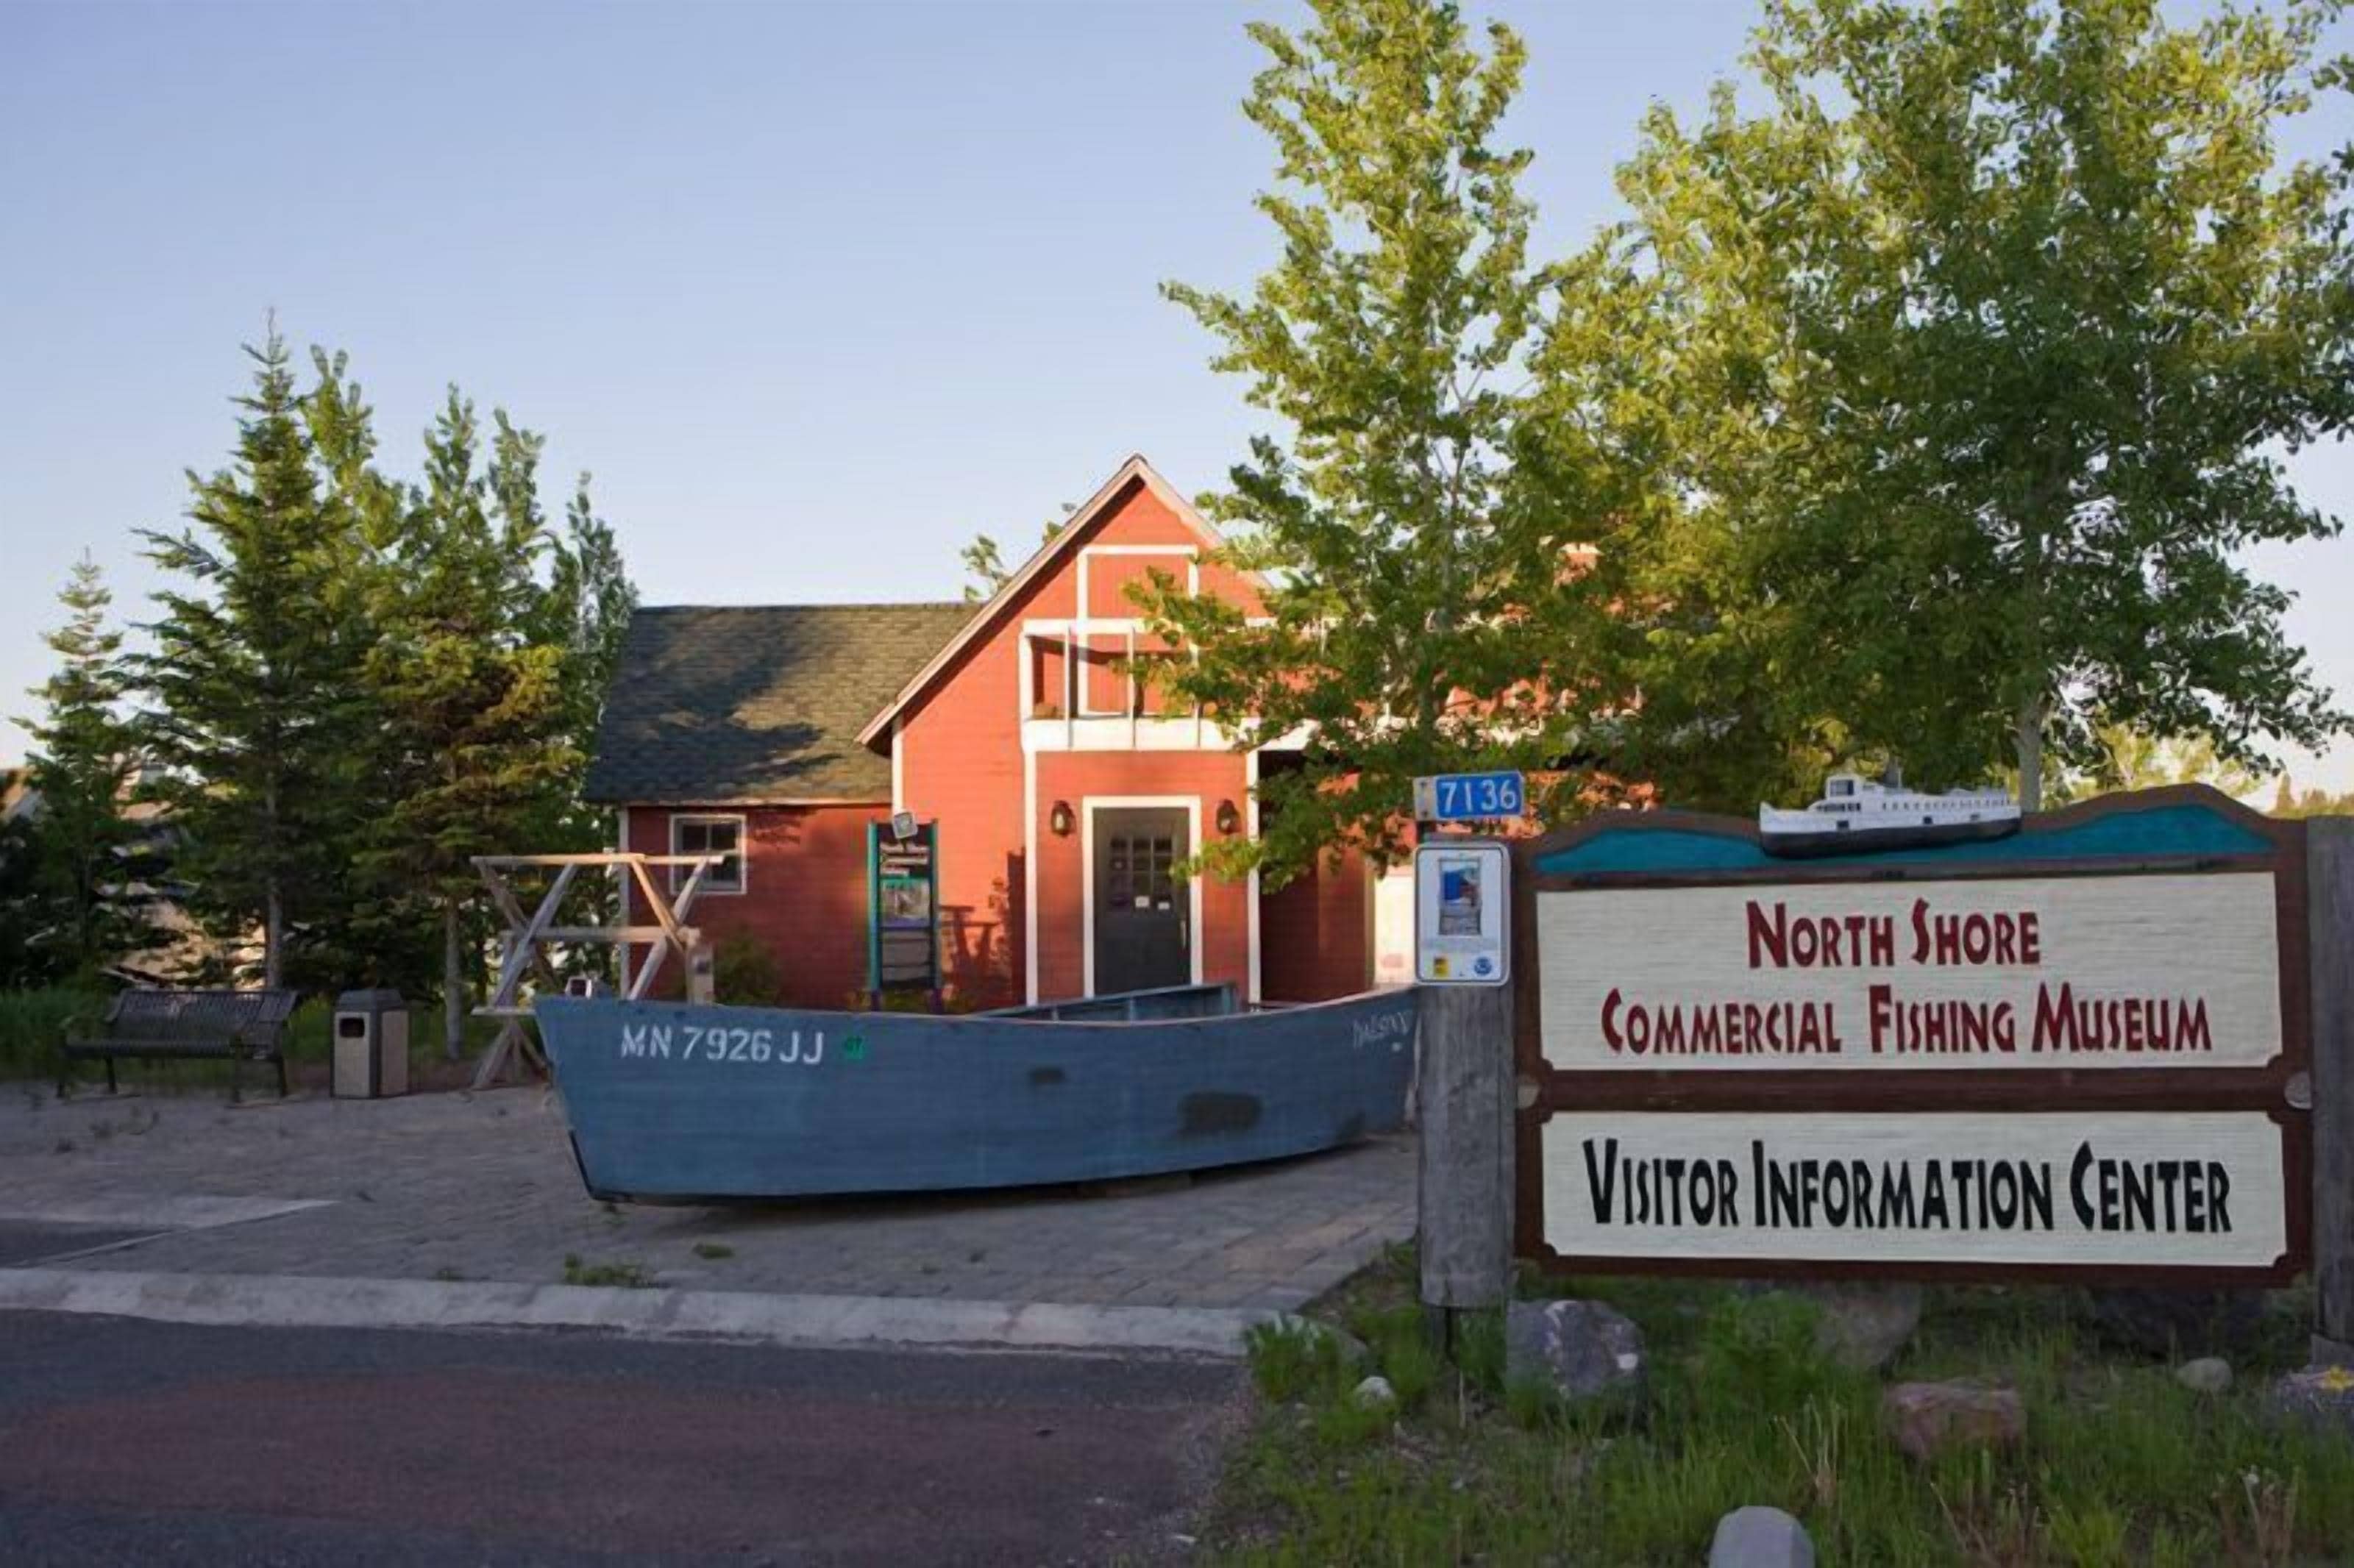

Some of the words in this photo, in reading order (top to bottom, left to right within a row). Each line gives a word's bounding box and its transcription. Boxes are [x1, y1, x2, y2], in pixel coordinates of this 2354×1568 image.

[1440, 780, 1516, 812] 7136
[1746, 900, 1895, 969] NORTH
[1911, 897, 2041, 966] SHORE
[620, 1024, 672, 1059] MN
[683, 1027, 772, 1062] 7926
[779, 1031, 823, 1065] JJ
[1601, 988, 1842, 1055] COMMERCIAL
[1868, 983, 2016, 1054] FISHING
[2031, 981, 2212, 1053] MUSEUM
[1582, 1137, 1740, 1227] VISITOR
[1752, 1139, 2055, 1232] INFORMATION
[2069, 1140, 2233, 1234] CENTER
